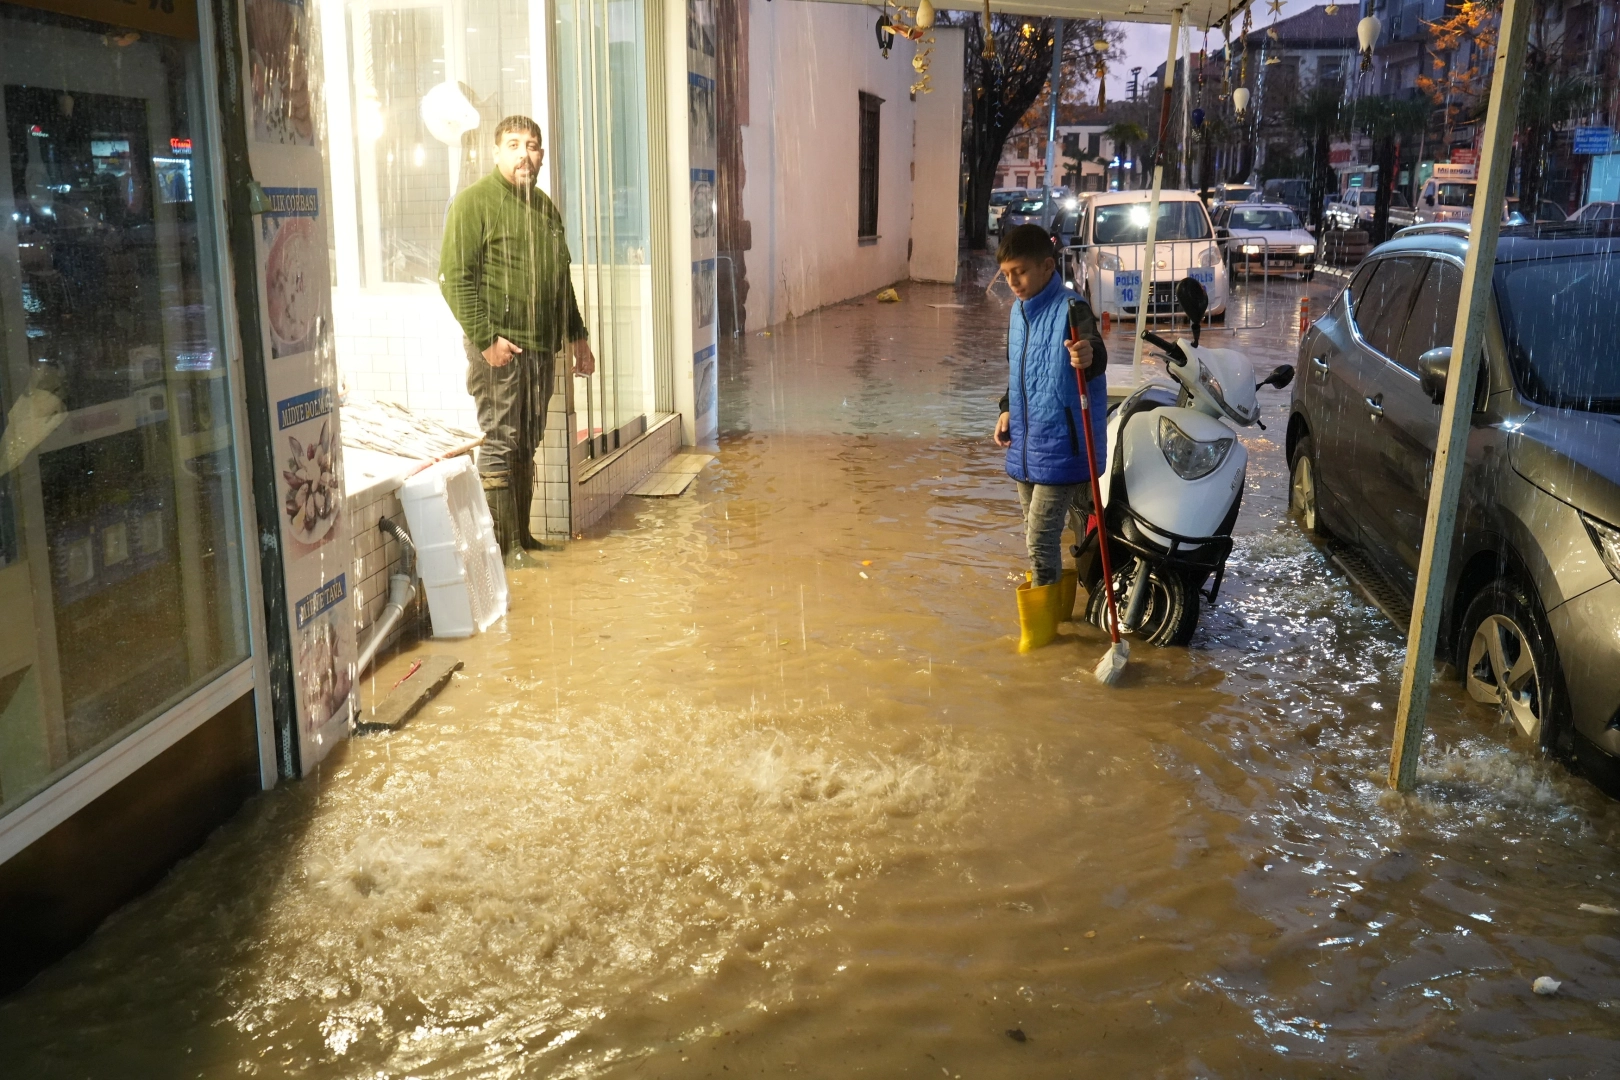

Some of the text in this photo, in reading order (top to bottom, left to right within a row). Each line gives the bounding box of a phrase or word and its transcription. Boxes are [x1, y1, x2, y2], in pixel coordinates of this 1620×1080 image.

[286, 194, 317, 216] ÇORBASI
[1116, 274, 1140, 286] POLİS
[1121, 288, 1134, 302] 10
[281, 402, 305, 428] MİDYE
[300, 581, 343, 621] MİDYE TAVA
